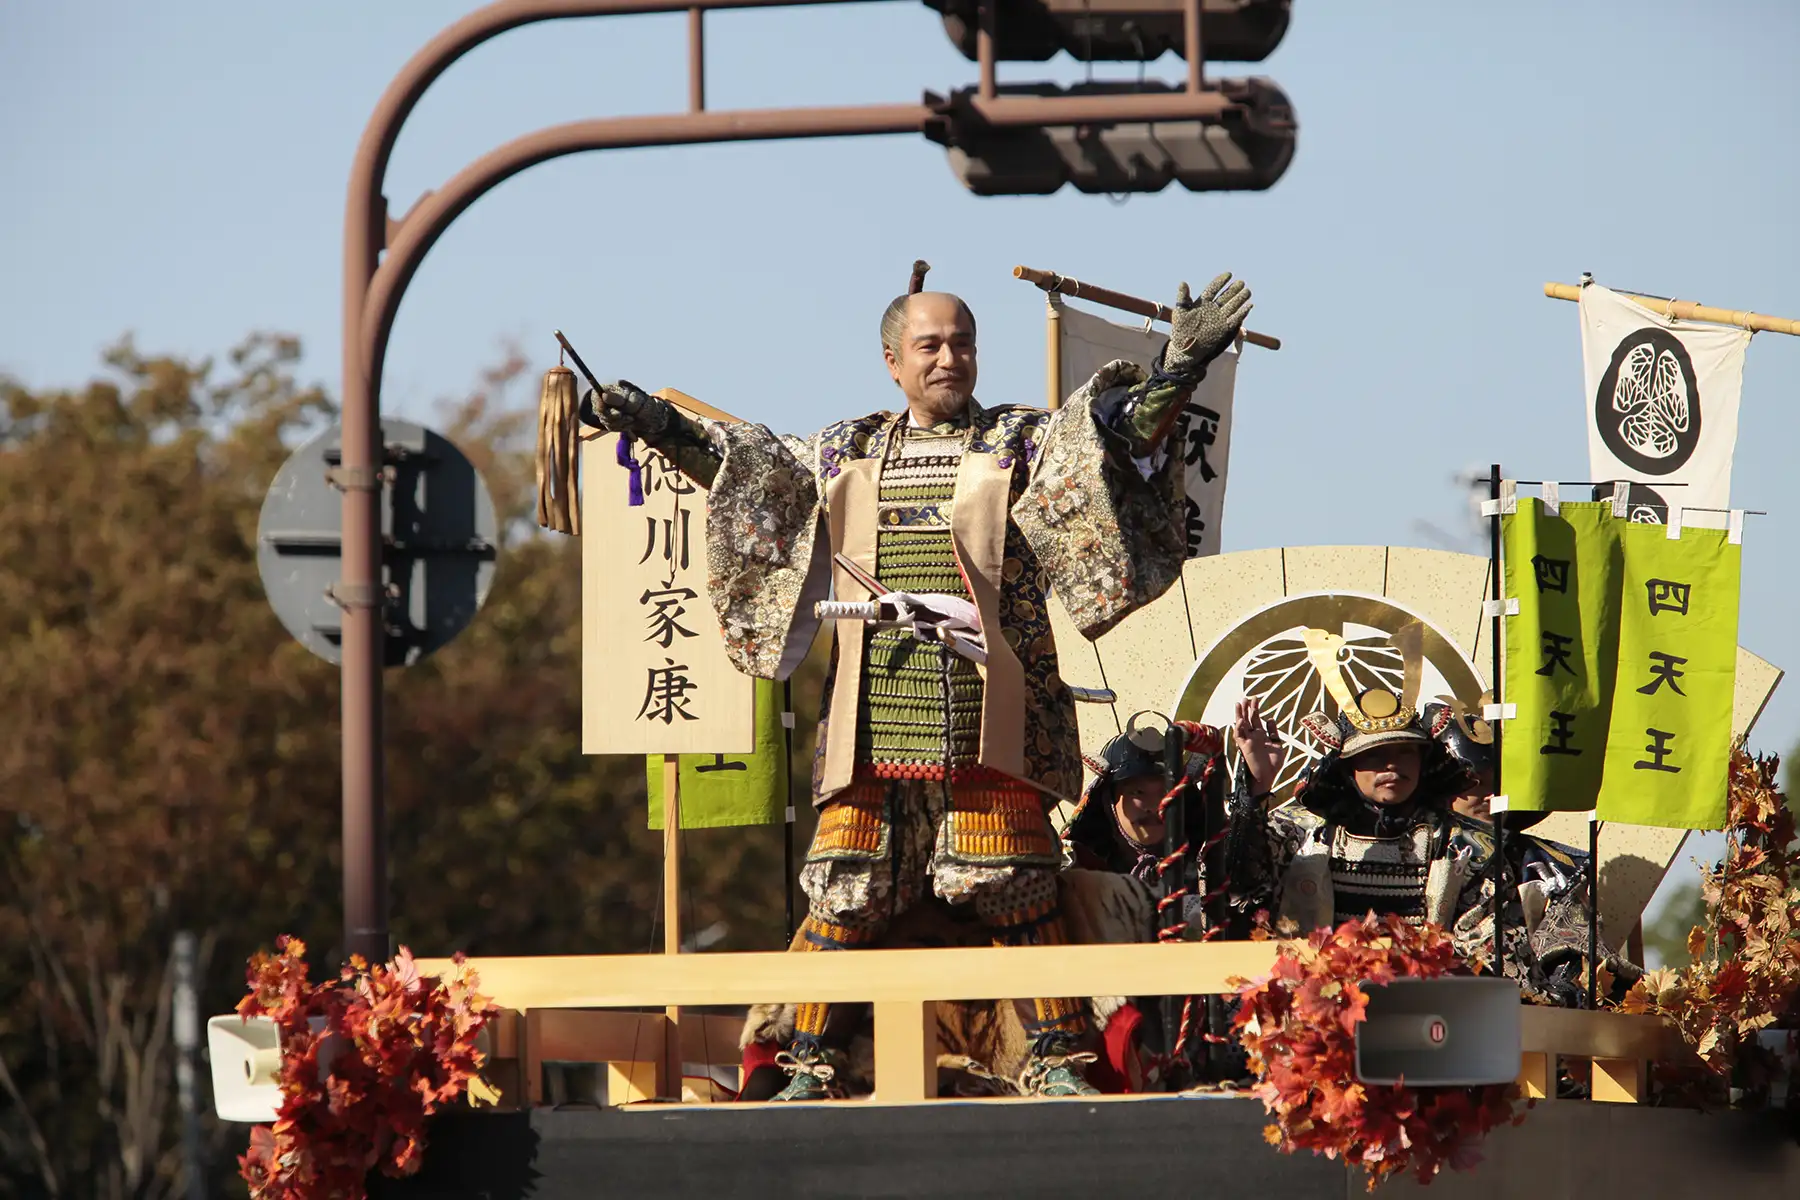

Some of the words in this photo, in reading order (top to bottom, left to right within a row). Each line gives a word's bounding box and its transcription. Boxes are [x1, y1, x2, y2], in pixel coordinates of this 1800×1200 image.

[1531, 553, 1583, 756] 四天王
[1633, 578, 1692, 773] 四天王
